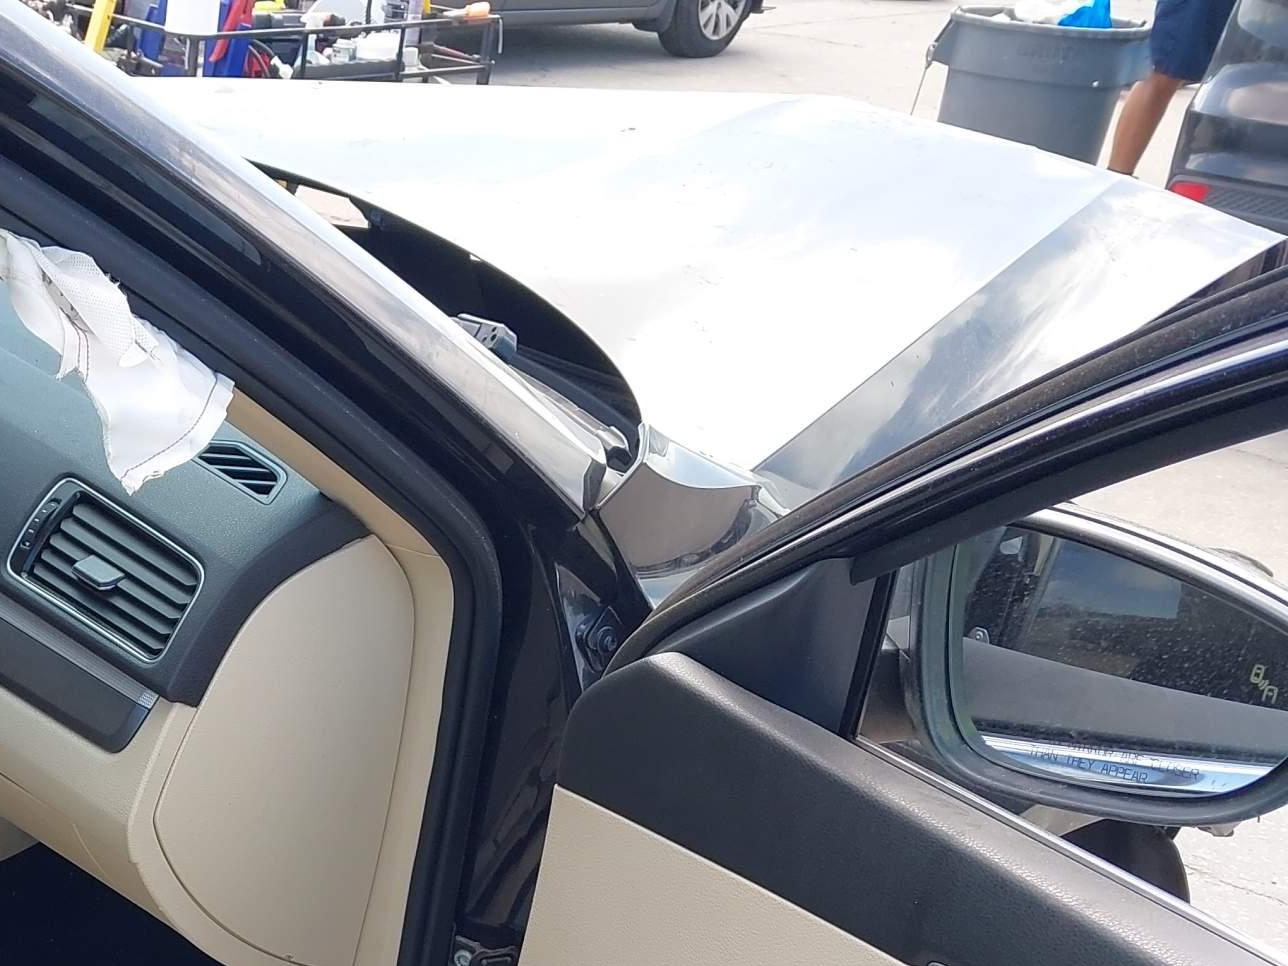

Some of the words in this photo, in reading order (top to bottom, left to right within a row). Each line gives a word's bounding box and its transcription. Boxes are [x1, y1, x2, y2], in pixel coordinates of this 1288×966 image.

[1030, 744, 1058, 763] THAN
[1066, 752, 1094, 770] THEY
[1100, 762, 1149, 784] APPEAR
